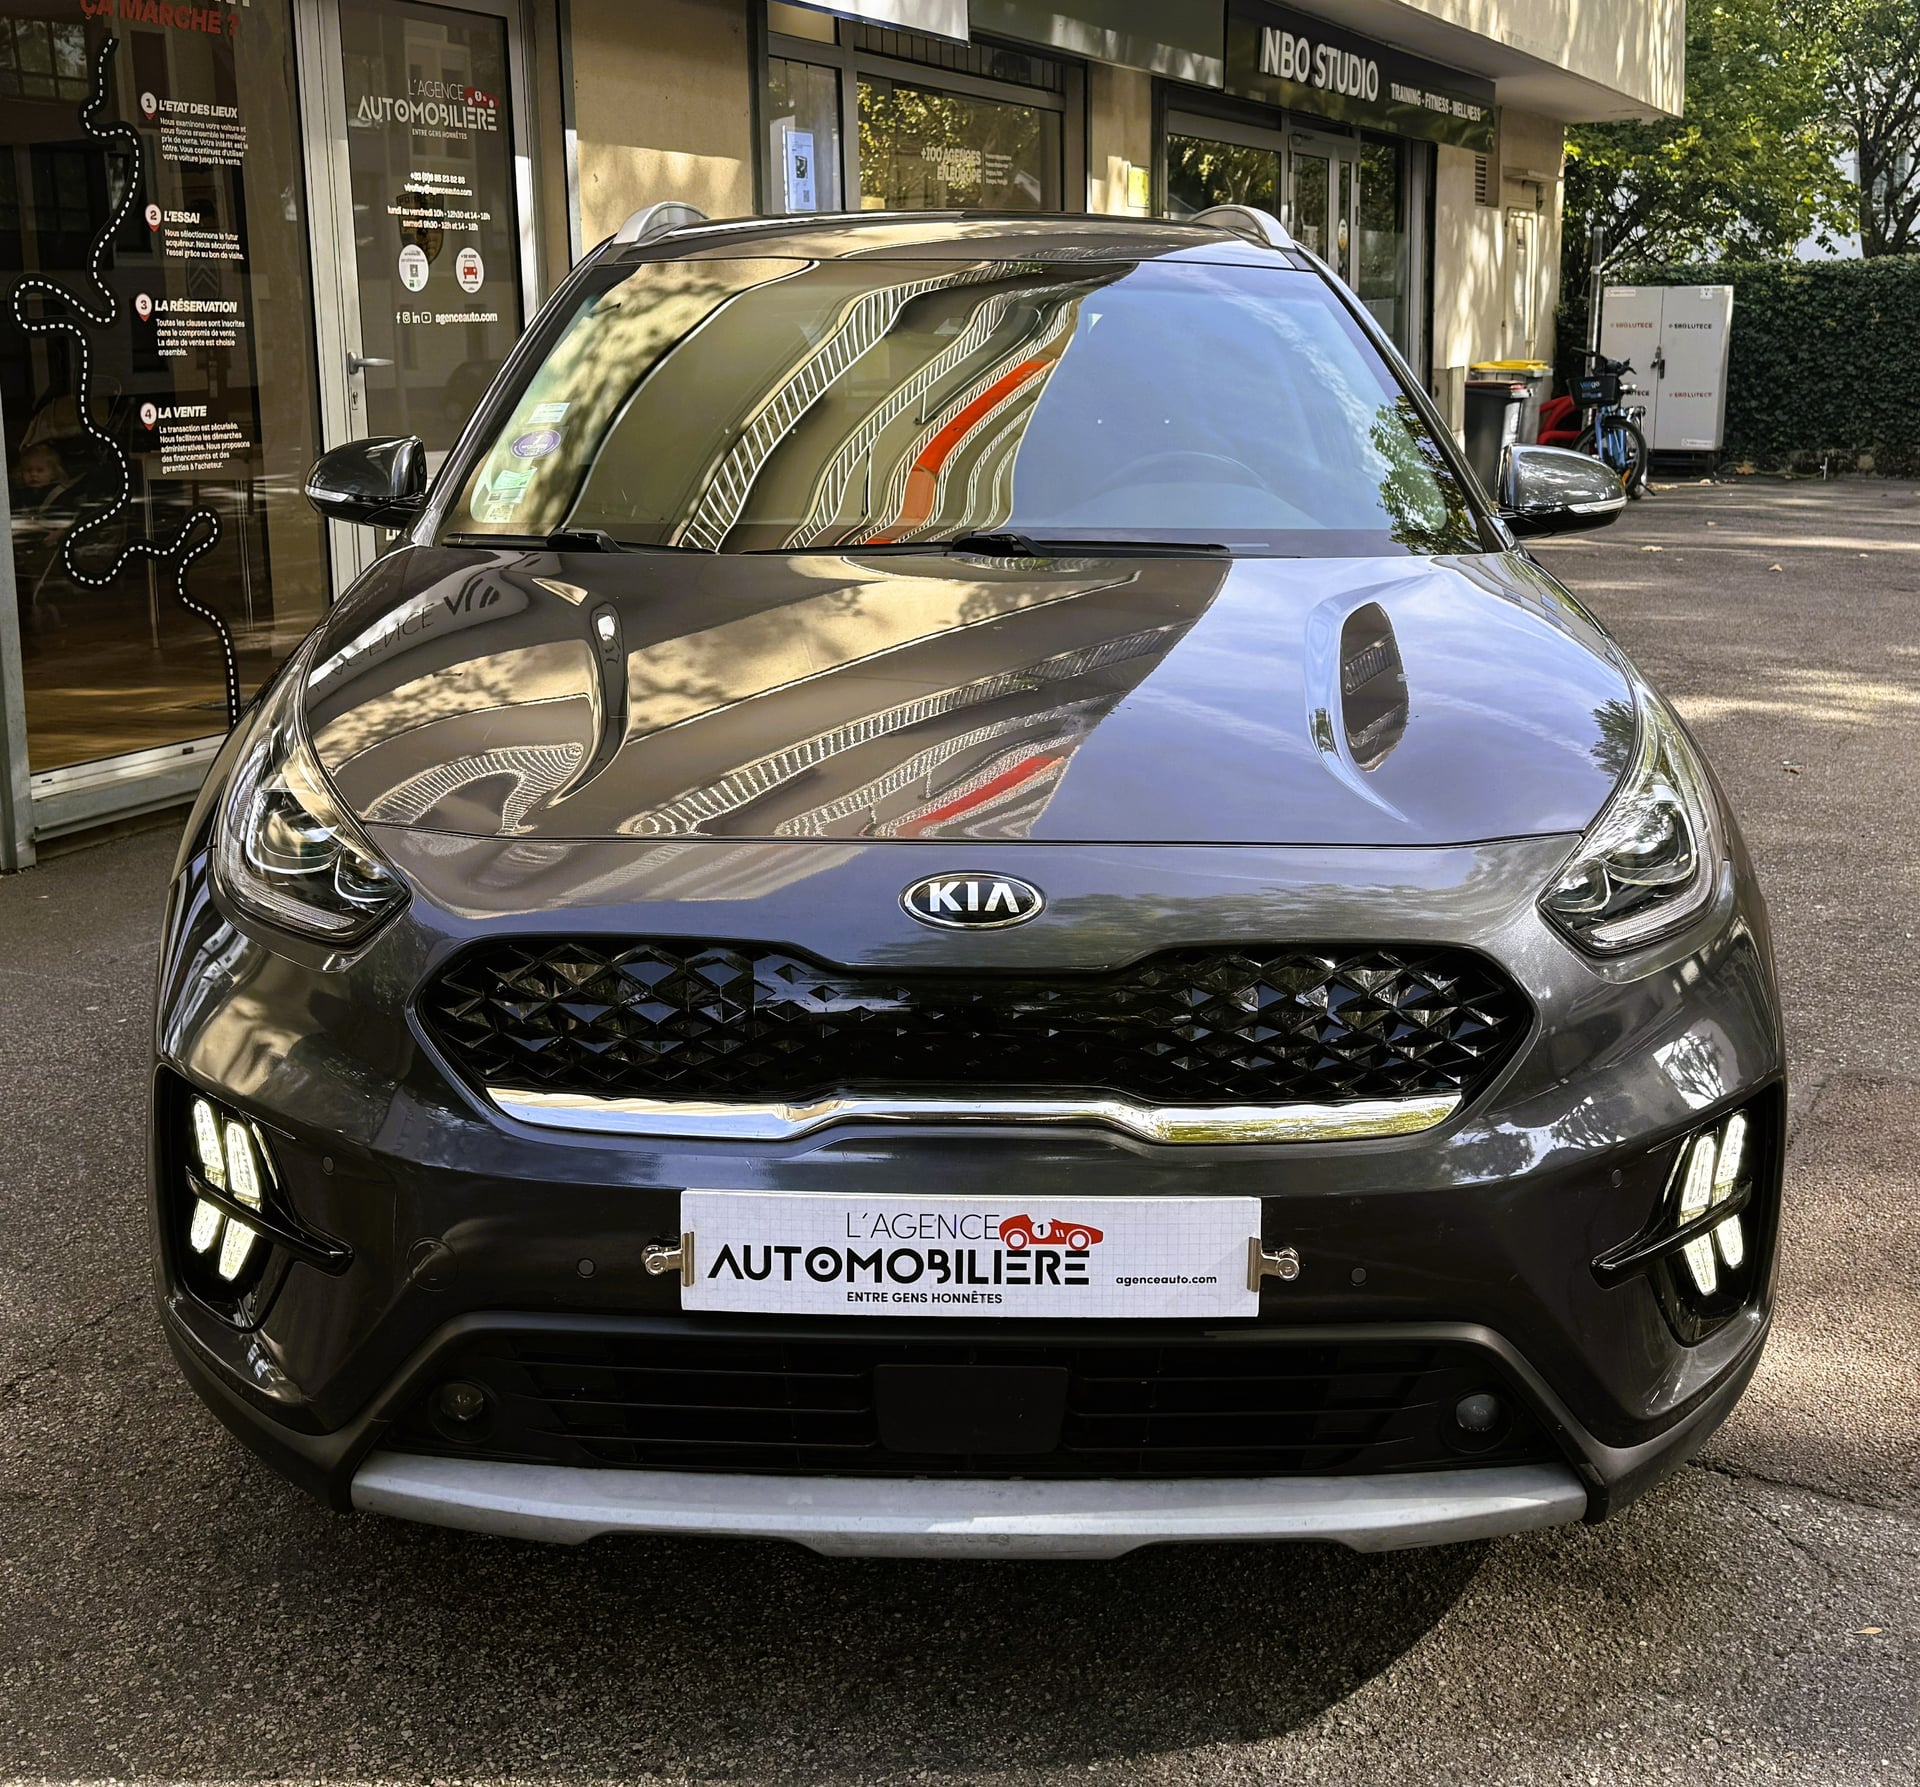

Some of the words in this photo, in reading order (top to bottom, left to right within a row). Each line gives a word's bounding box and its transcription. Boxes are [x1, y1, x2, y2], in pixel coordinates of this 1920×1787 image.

[119, 0, 224, 34] MARCHE
[1260, 27, 1311, 83] NBO
[1314, 43, 1379, 102] STUDIO
[407, 77, 465, 101] L'AGENCE
[1390, 82, 1421, 106] TRAINING
[1425, 92, 1449, 114] FITNESS
[159, 100, 189, 113] L'ETAT
[190, 103, 209, 116] DES
[211, 105, 238, 119] LIEUX
[412, 129, 428, 137] ENTRE
[428, 130, 442, 138] GENS
[164, 210, 200, 224] L'ESSAI
[165, 229, 179, 237] Nous
[196, 241, 210, 249] Nous
[155, 300, 169, 312] LA
[170, 298, 238, 313] RÉSERVATION
[156, 319, 175, 327] Toutes
[435, 312, 498, 325] agenceauto.com
[157, 339, 165, 347] La
[166, 339, 179, 347] date
[158, 407, 172, 419] LA
[173, 405, 207, 418] VENTE
[159, 426, 167, 434] La
[160, 435, 175, 443] Nous
[206, 442, 221, 450] Nous
[928, 881, 1020, 913] KIA
[846, 1212, 1000, 1240] L'AGENCE
[1036, 1222, 1046, 1238] 1
[1115, 1274, 1217, 1287] agenceauto.com
[846, 1291, 888, 1304] ENTRE
[891, 1291, 928, 1304] GENS
[931, 1289, 1003, 1304] HONNÊTES
